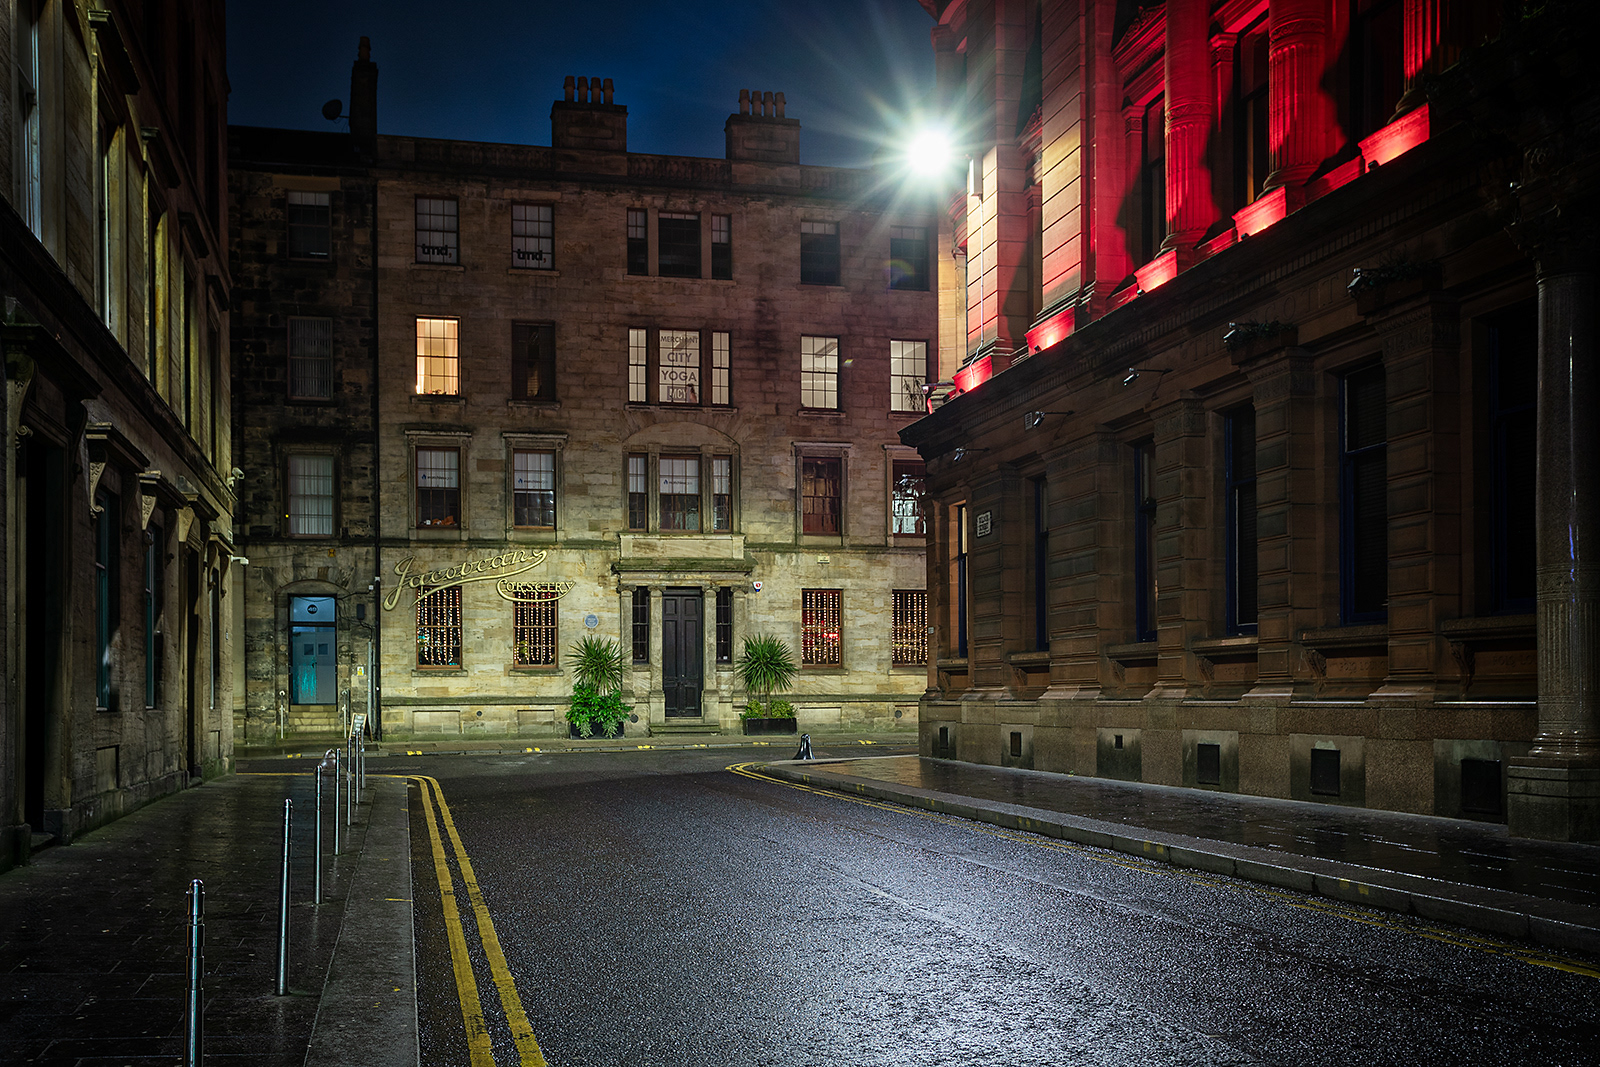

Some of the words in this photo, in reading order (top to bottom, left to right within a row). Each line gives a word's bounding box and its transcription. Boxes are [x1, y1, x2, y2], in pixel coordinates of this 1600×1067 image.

[660, 335, 698, 344] MERCHANT
[667, 351, 692, 363] CITY
[661, 370, 697, 382] YOGA
